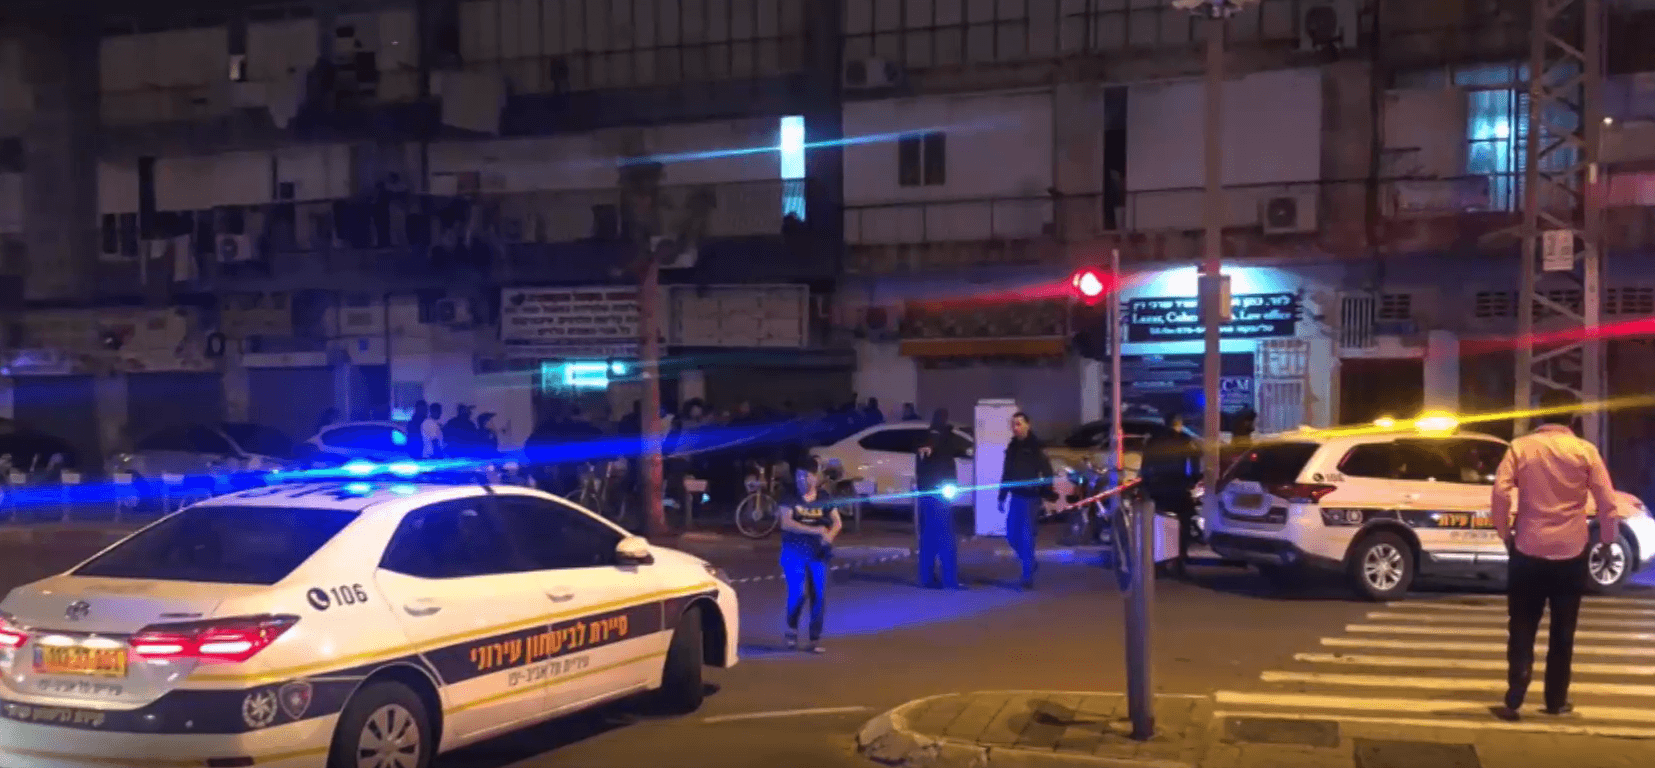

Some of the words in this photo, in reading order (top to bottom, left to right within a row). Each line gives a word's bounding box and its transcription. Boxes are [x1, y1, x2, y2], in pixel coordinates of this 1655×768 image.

[330, 584, 368, 607] 106
[525, 621, 586, 665] לביטחון
[588, 615, 628, 644] סיירת
[470, 638, 523, 671] עירוני
